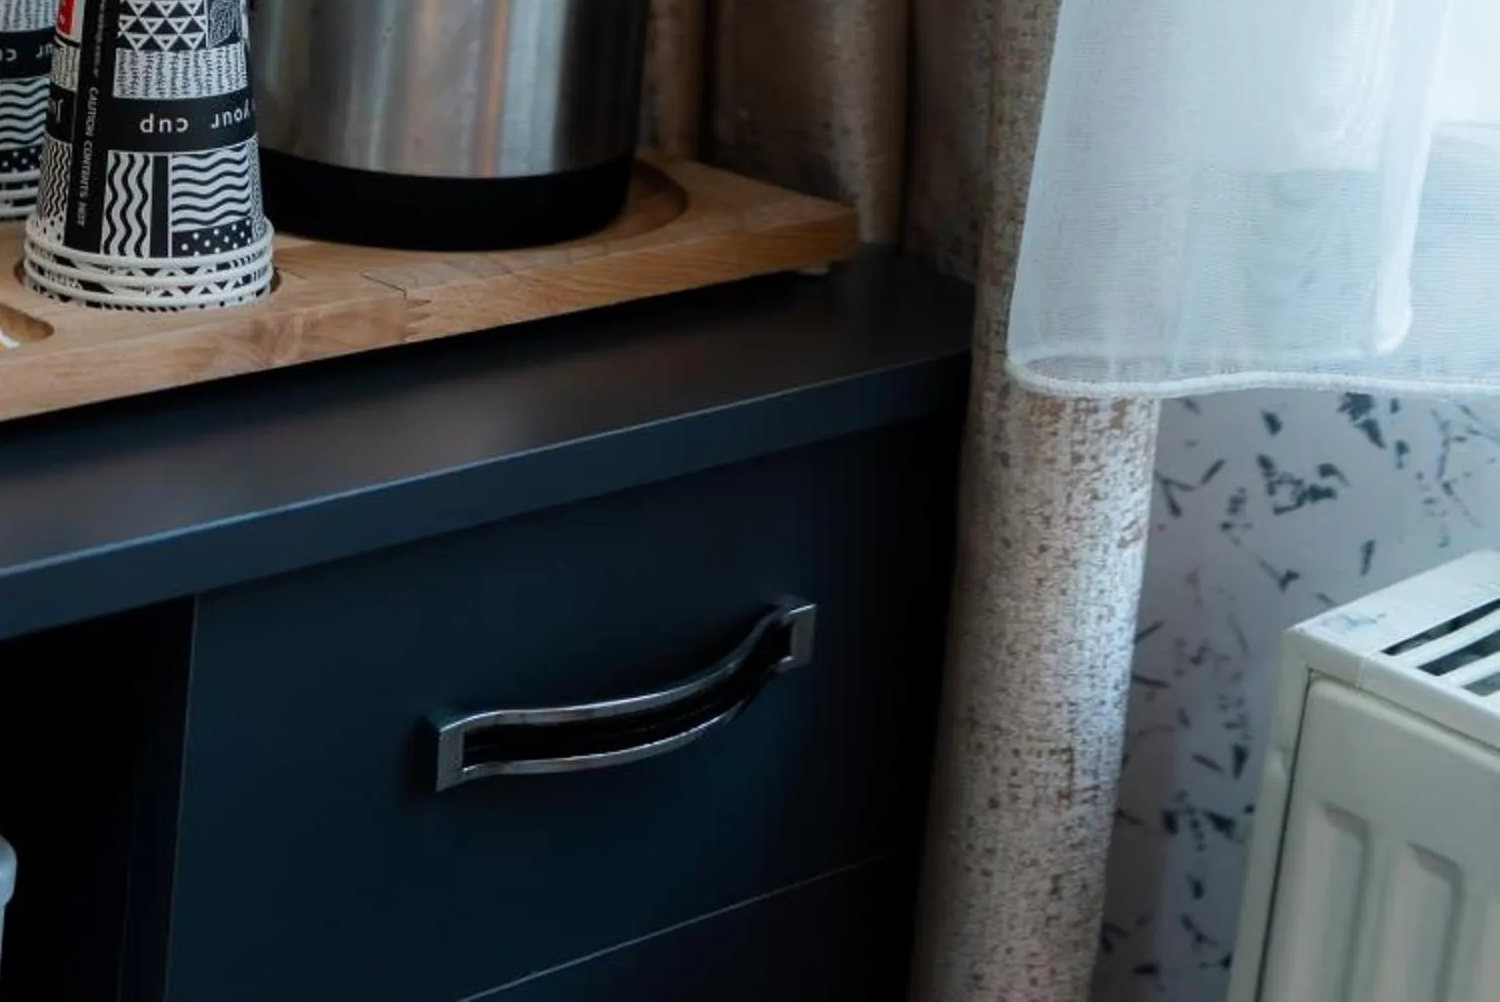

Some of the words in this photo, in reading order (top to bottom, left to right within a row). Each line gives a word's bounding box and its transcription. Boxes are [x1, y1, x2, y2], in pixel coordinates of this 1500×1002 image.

[85, 86, 100, 137] CAUTION
[139, 113, 190, 134] cup
[211, 97, 251, 130] your
